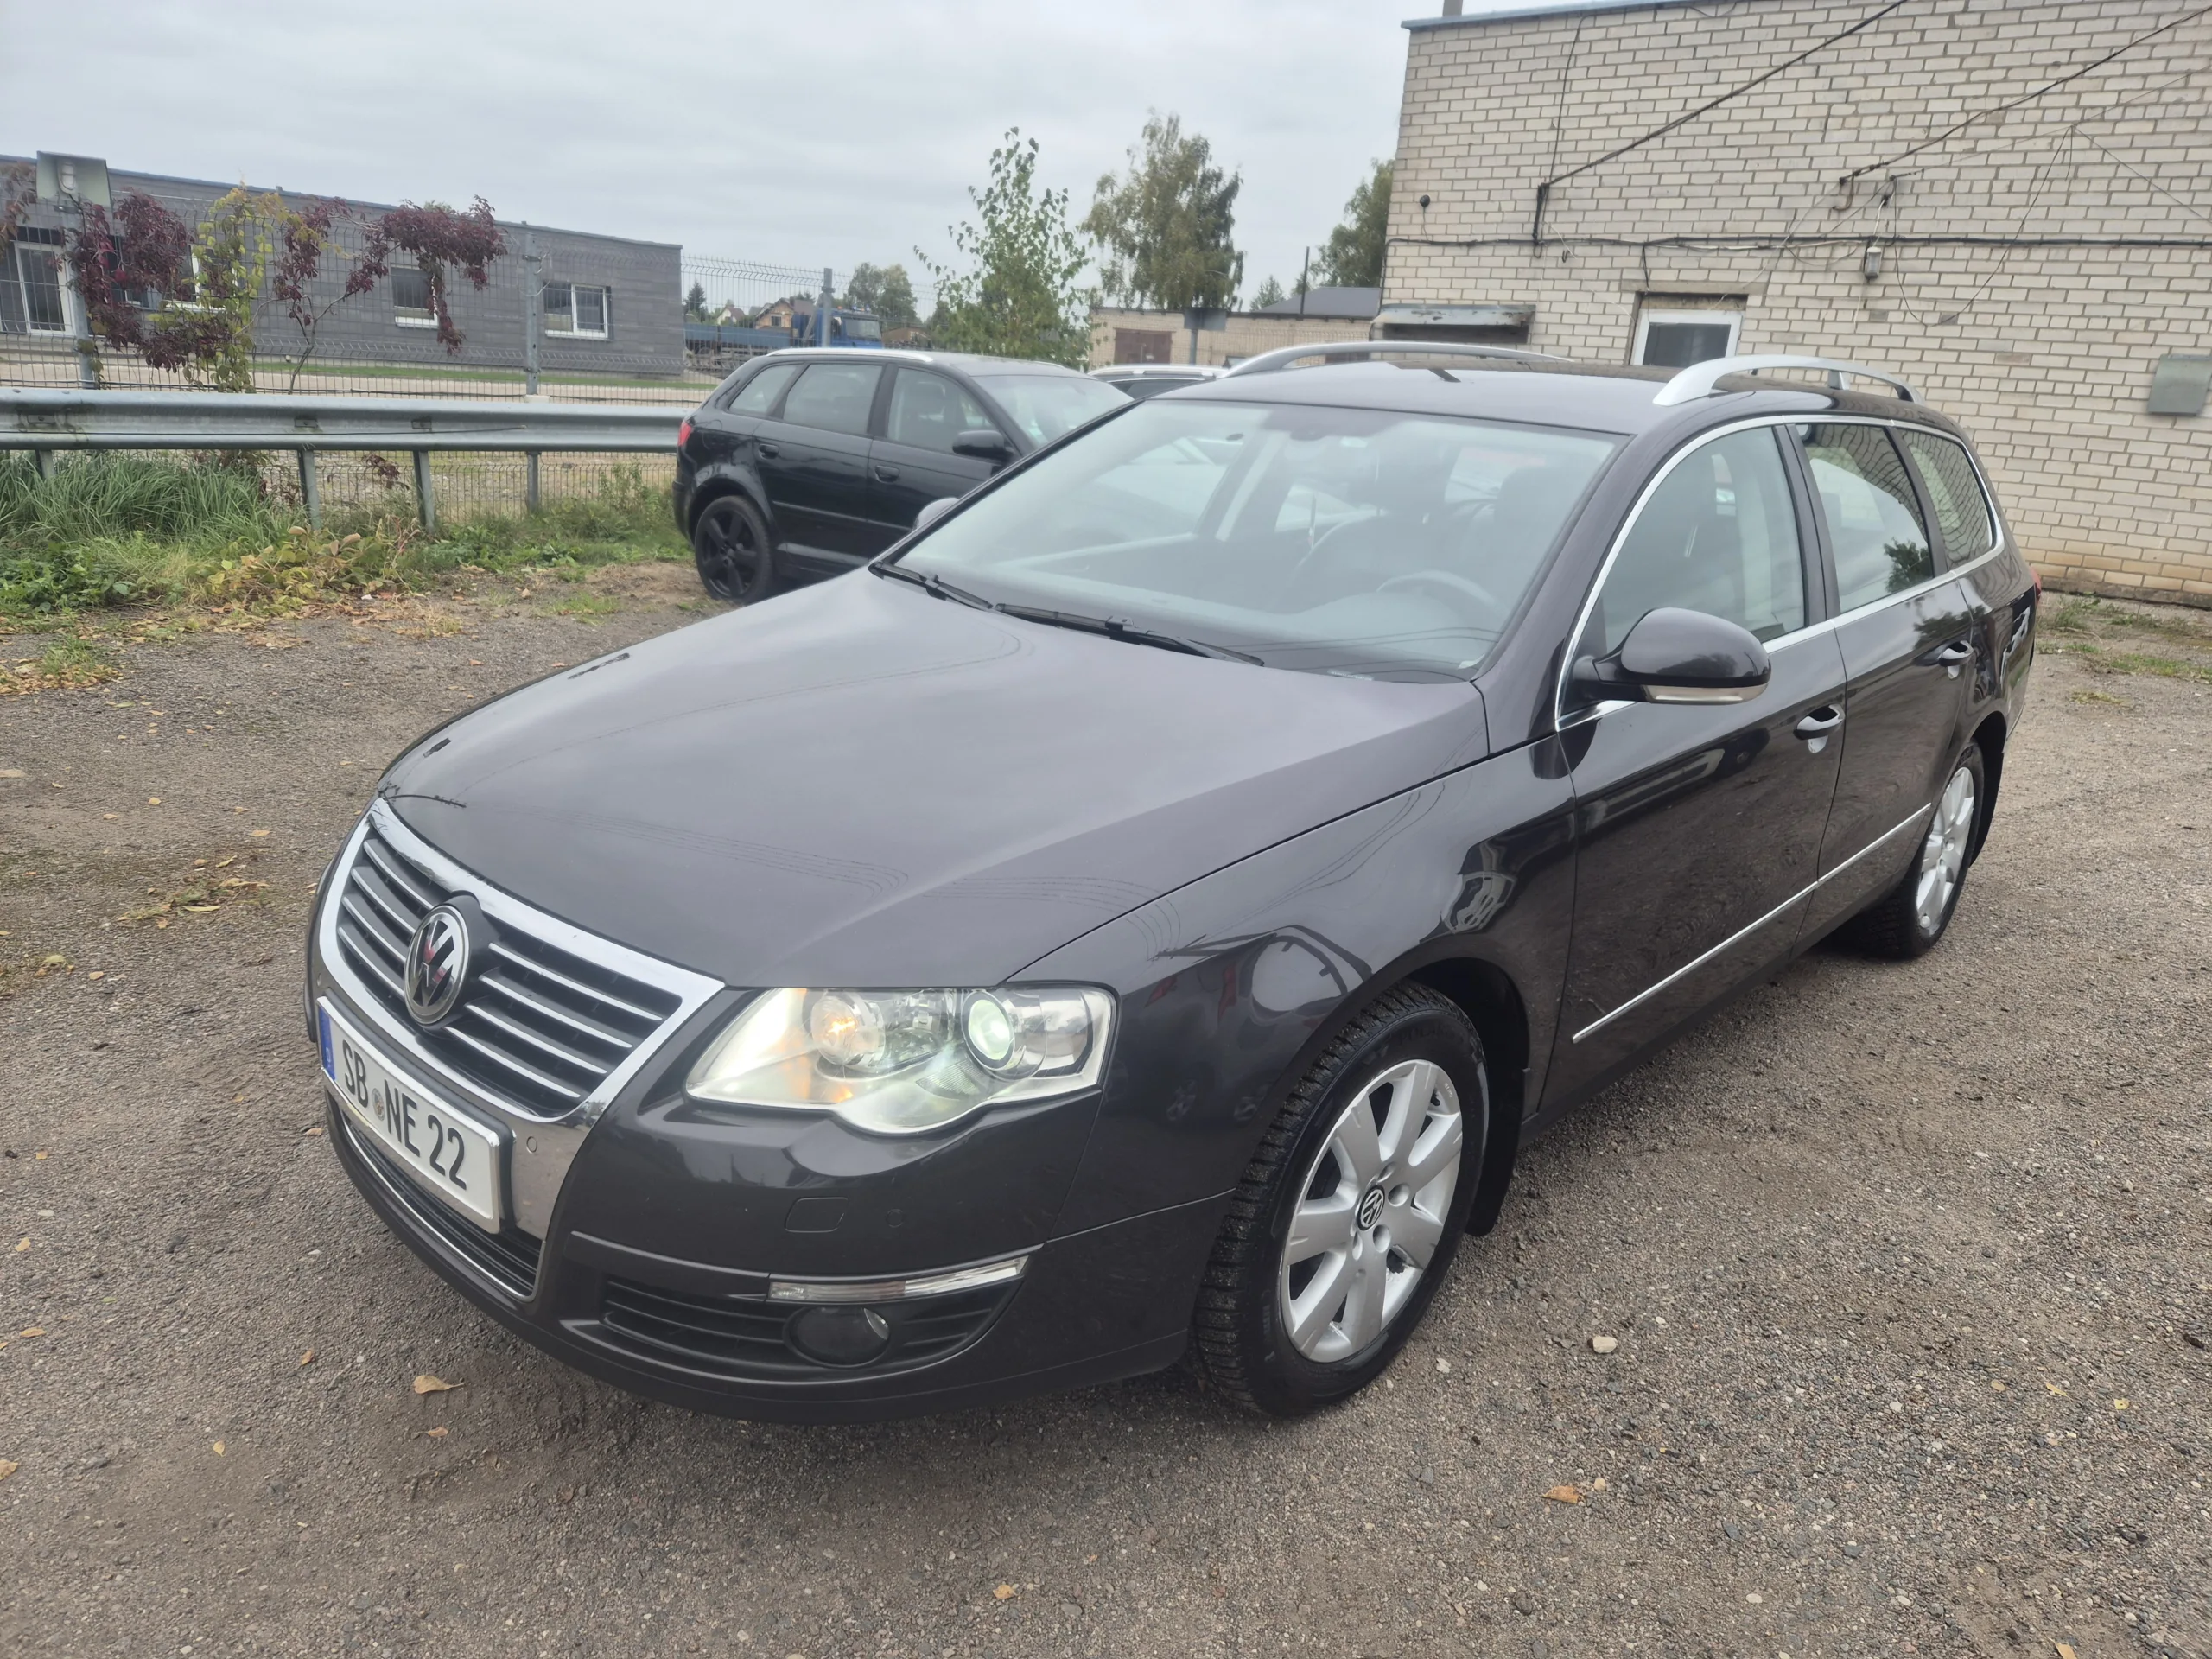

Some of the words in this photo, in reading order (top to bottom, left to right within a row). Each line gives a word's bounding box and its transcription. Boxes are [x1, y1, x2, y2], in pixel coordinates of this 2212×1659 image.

[342, 1039, 369, 1109] SB
[384, 1079, 421, 1158] NE
[427, 1114, 467, 1190] 22
